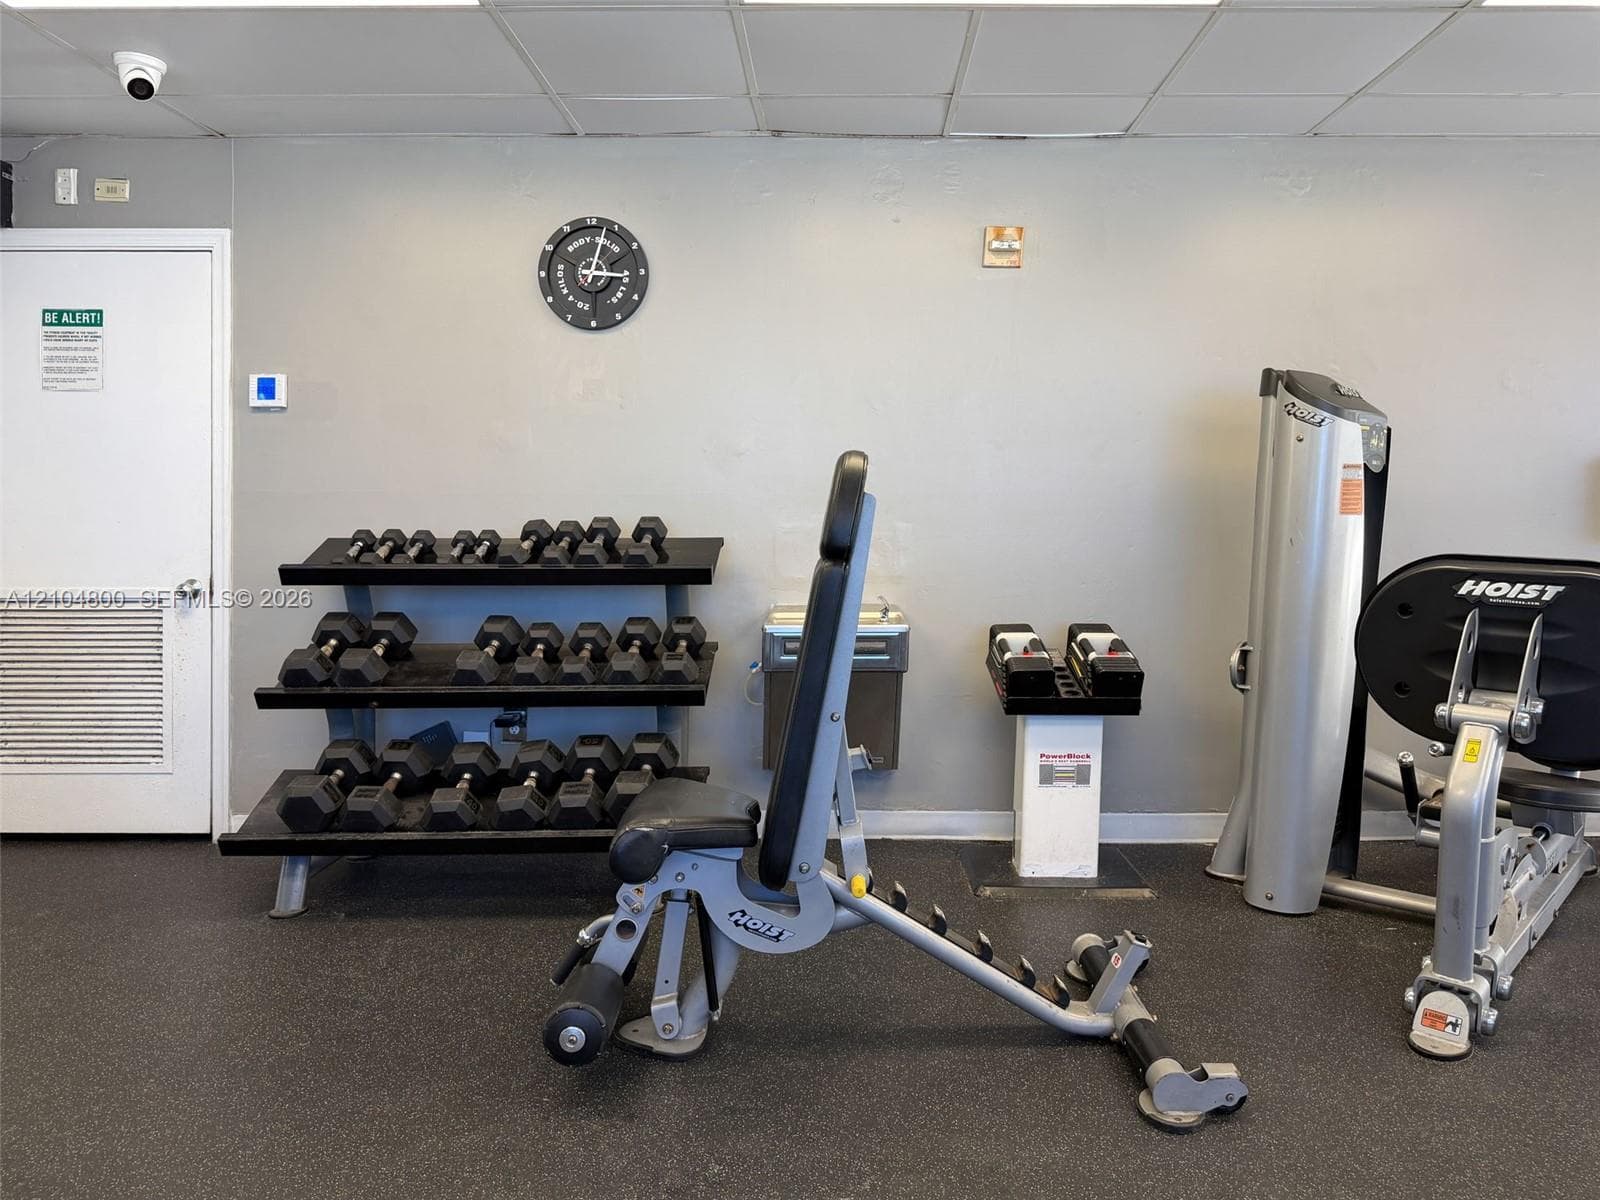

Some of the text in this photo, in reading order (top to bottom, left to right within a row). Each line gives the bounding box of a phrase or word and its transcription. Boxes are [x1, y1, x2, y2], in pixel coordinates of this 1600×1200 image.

[562, 225, 571, 233] 11
[567, 236, 620, 253] BODY-SOLID
[631, 242, 639, 250] 2
[556, 264, 569, 295] KILOS
[632, 293, 639, 301] 4
[44, 312, 101, 324] BE ALERT!
[565, 314, 572, 322] 7
[1284, 402, 1335, 427] HOIST
[1457, 579, 1566, 601] HOIST
[729, 910, 795, 941] HOIST
